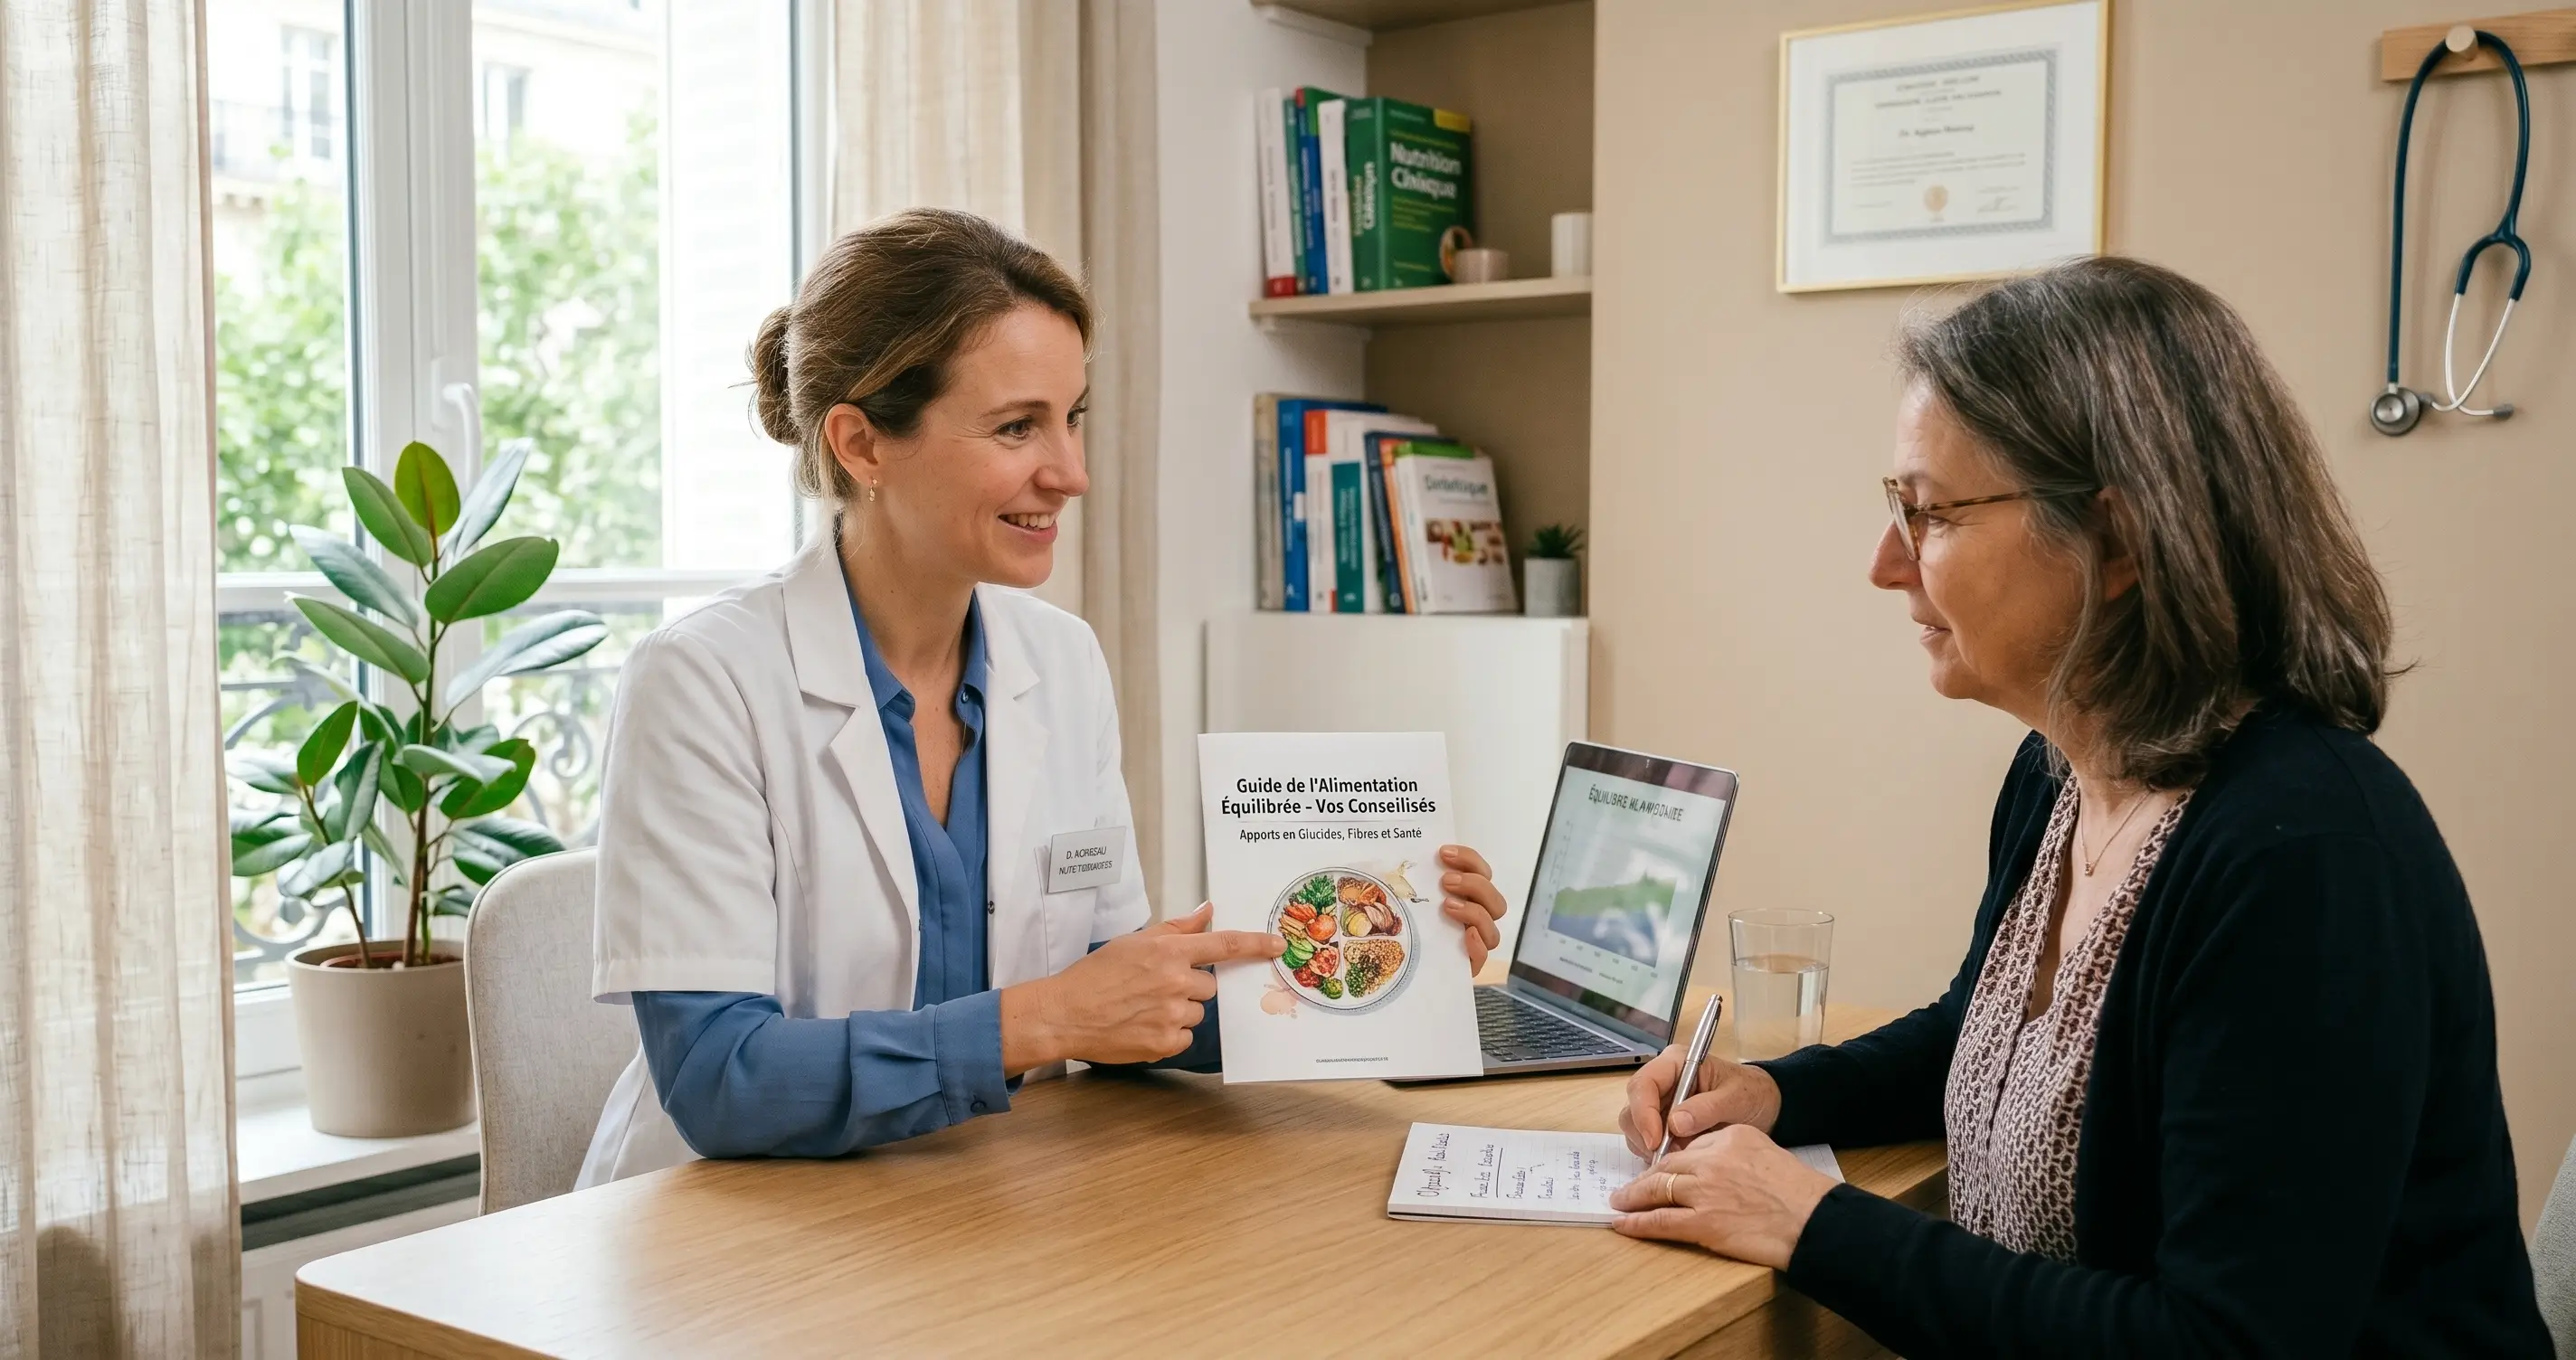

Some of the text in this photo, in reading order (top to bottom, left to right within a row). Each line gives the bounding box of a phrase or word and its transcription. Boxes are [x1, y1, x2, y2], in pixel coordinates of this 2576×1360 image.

[1236, 777, 1418, 793] Guide de l'Alimentation
[1221, 796, 1302, 818] Équilibrée
[1315, 799, 1344, 814] Vos
[1348, 797, 1436, 814] Conseilisés
[1239, 827, 1422, 843] Apports en Glucides, Fibres et Santé
